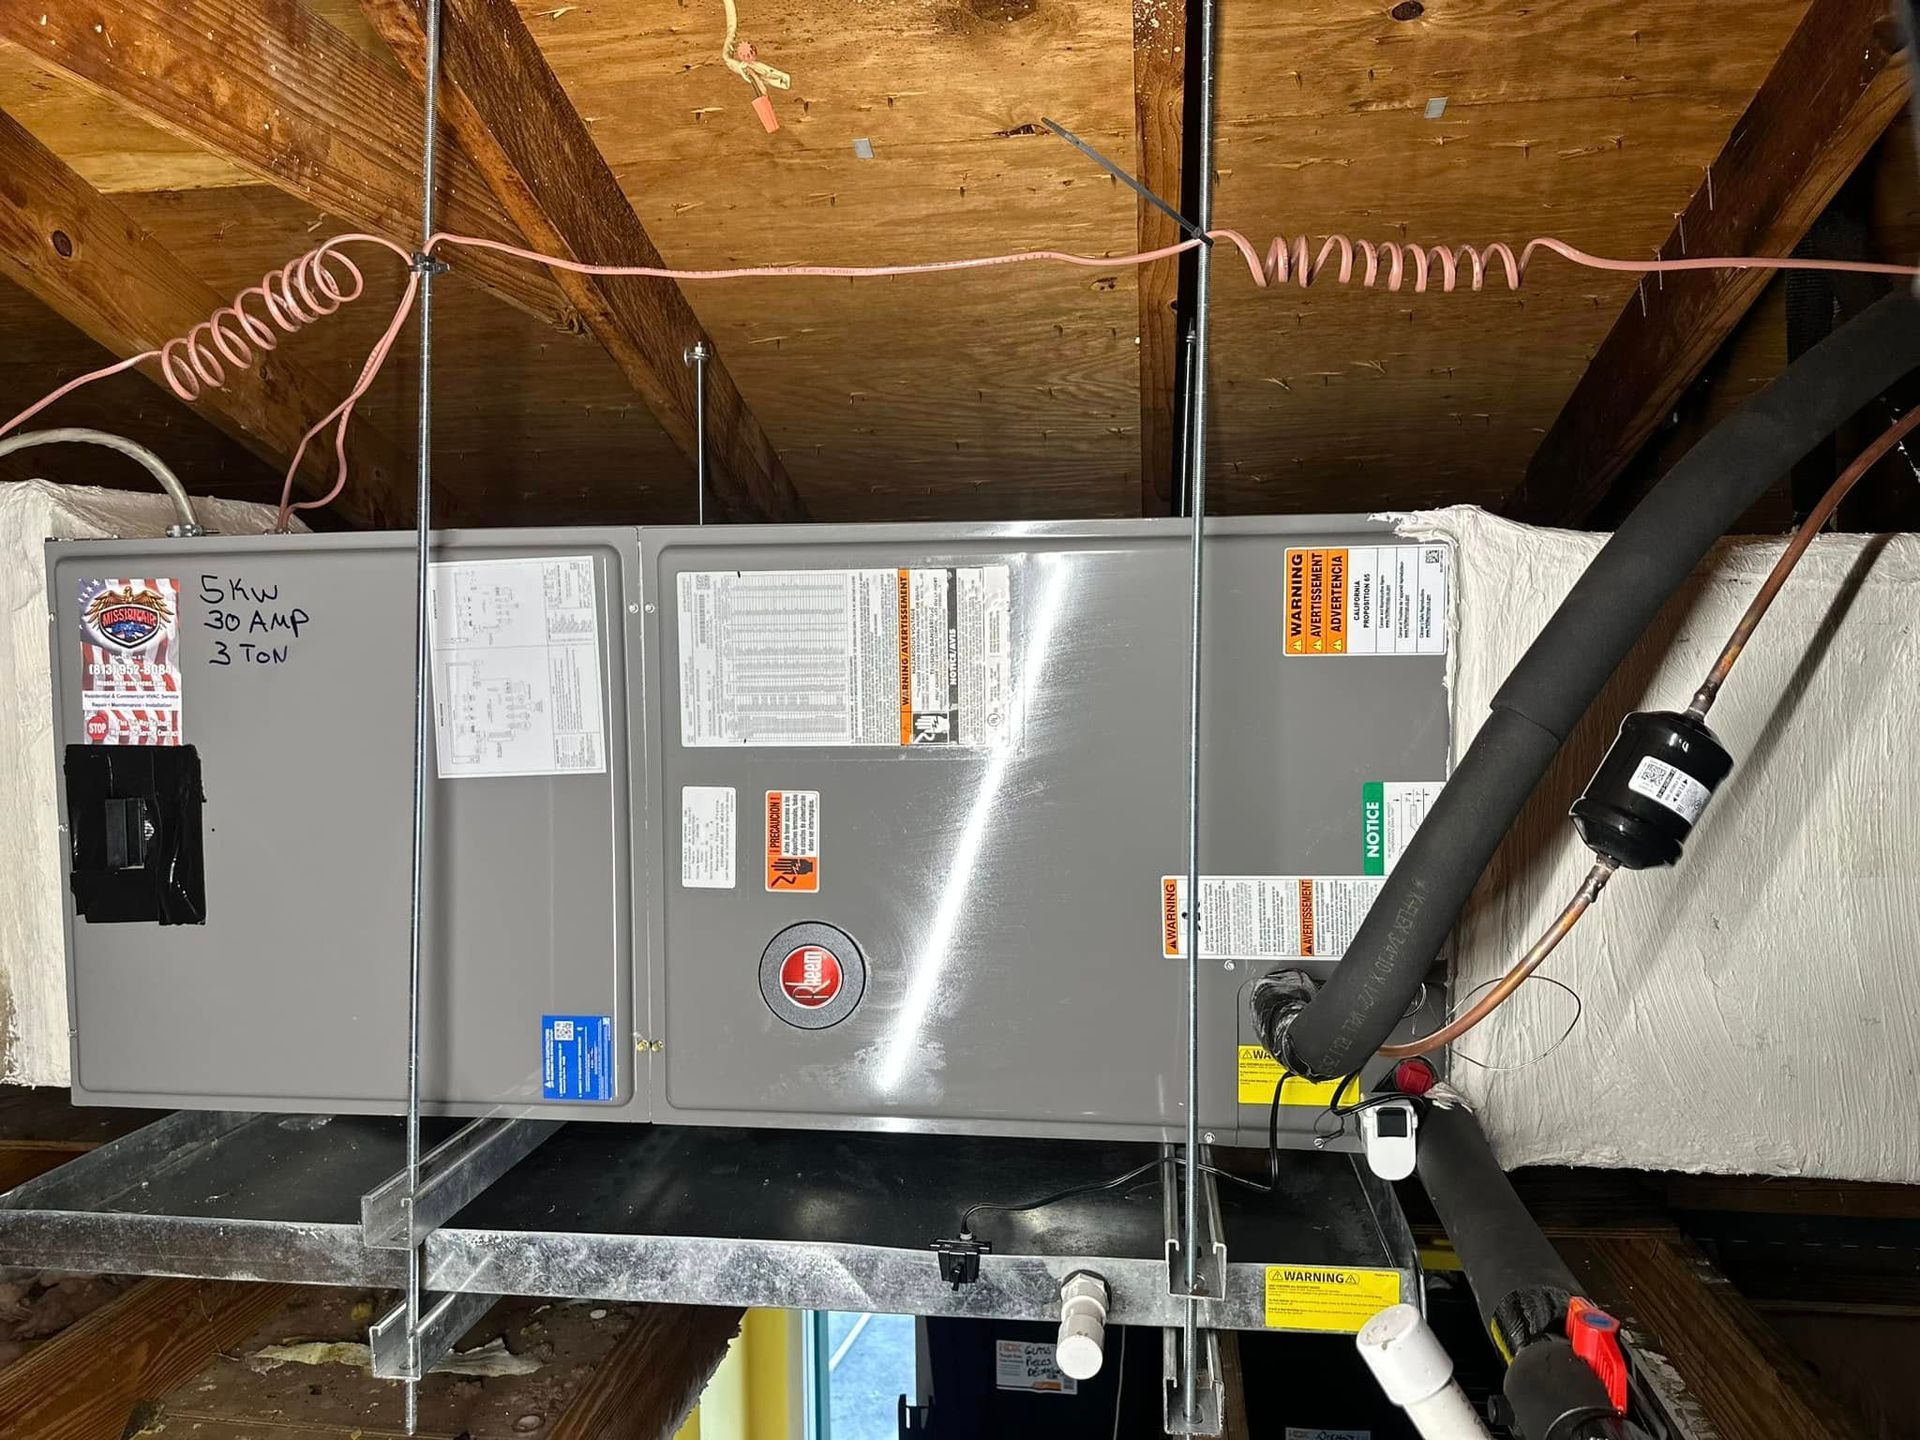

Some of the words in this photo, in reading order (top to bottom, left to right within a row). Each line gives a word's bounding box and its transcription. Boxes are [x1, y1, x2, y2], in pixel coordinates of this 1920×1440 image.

[200, 575, 224, 604] 5
[1291, 554, 1302, 636] WARNING
[1311, 553, 1322, 637] AVERTISSEMENT
[1331, 556, 1342, 632] ADVERTENCIA
[1364, 574, 1370, 582] 65
[204, 610, 241, 632] 30
[249, 608, 309, 638] AMP
[900, 576, 909, 705] WARNING/AVERTISSEMENT
[209, 641, 231, 665] 3
[88, 722, 107, 733] STOP
[770, 802, 780, 848] PRECAUCION
[1366, 802, 1380, 857] NOTICE
[1166, 884, 1176, 940] WARNING
[1302, 880, 1313, 945] AVERTISSEMENT
[785, 951, 831, 999] Rheem
[1284, 1271, 1344, 1284] WARNING
